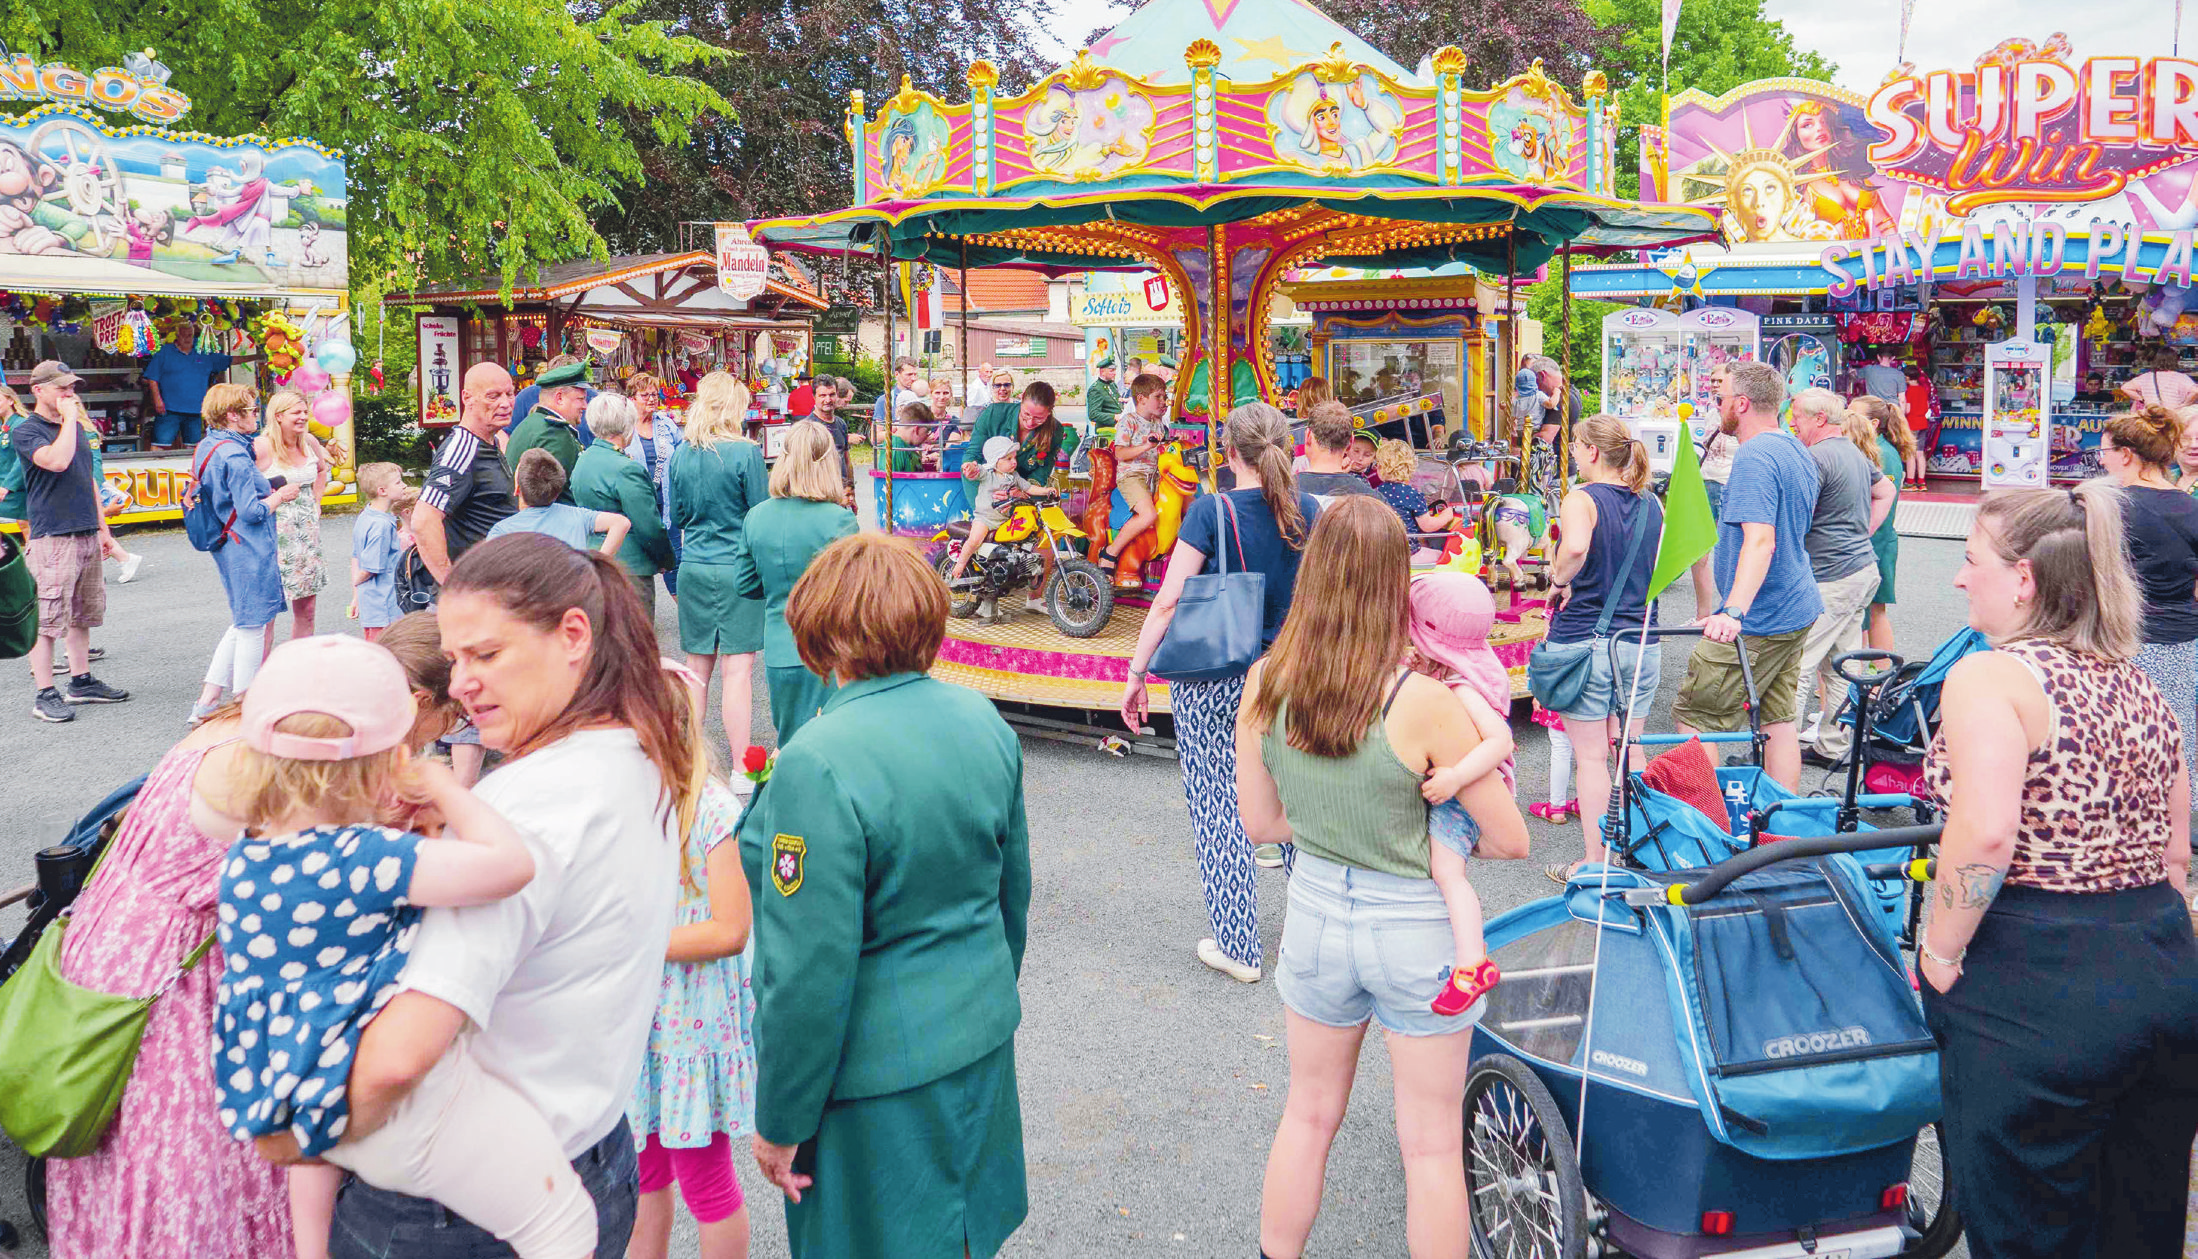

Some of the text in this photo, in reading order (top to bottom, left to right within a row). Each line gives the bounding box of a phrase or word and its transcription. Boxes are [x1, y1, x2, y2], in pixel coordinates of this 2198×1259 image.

[1865, 57, 2198, 166] SUPER
[1945, 127, 2127, 218] Win
[721, 252, 764, 272] Mandeln
[1820, 227, 1943, 298] STAY
[1956, 222, 2066, 280] AND
[1083, 297, 1131, 316] Softeis
[1763, 316, 1829, 325] PINK DATE
[1765, 1028, 1870, 1058] CROOZER
[1592, 1051, 1648, 1076] CROOZER
